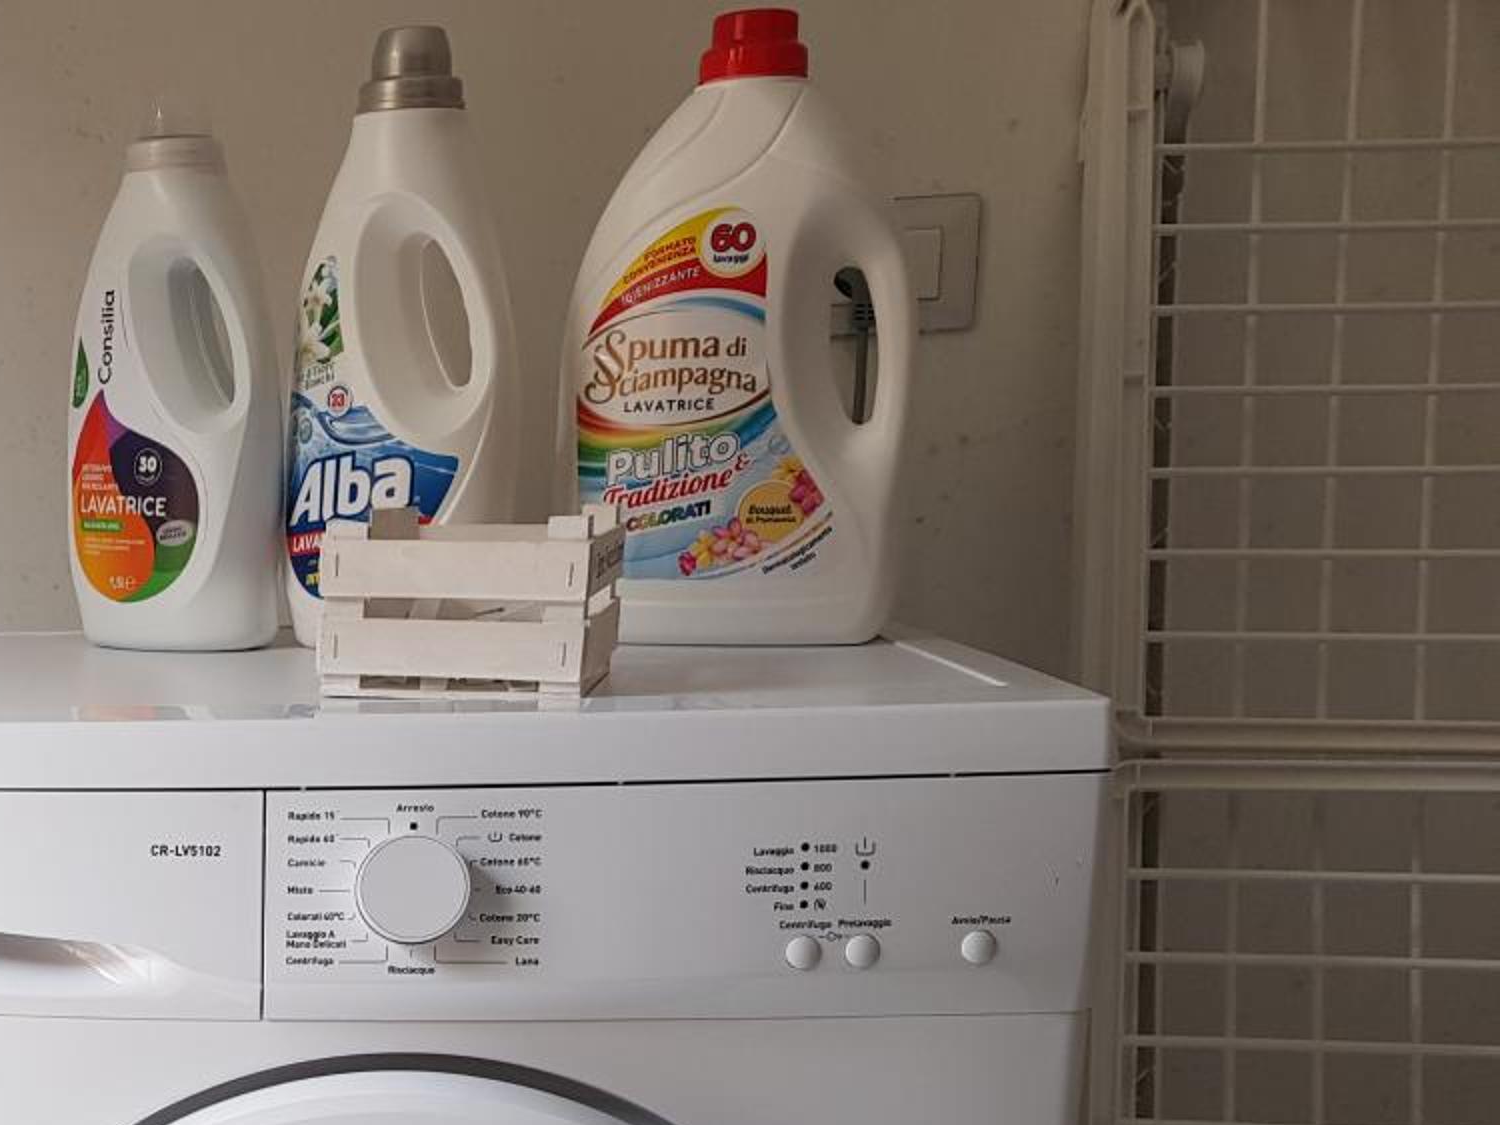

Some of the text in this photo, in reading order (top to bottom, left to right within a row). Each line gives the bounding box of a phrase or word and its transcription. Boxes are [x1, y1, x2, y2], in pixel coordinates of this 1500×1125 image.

[711, 222, 757, 253] 60
[644, 236, 697, 261] FORMATO
[713, 253, 750, 264] lavaggi
[623, 246, 697, 284] CONVENIENZA
[620, 266, 702, 305] IGIENIZZANTE
[97, 289, 116, 385] Consilia
[593, 330, 748, 380] Spuma di
[585, 360, 757, 405] Sciampagna
[624, 398, 715, 414] LAVATRICE
[607, 432, 740, 484] Pulito
[289, 456, 411, 527] Alba
[603, 468, 733, 508] Tradizione
[80, 495, 168, 518] LAVATRICE
[626, 500, 712, 532] COLORATI
[396, 803, 435, 813] Arresto
[480, 809, 516, 819] Cotone
[287, 811, 321, 822] Rapido
[287, 834, 321, 845] Rapido
[508, 832, 543, 843] Cotone
[150, 844, 222, 858] CR-LV5102
[753, 847, 795, 857] Lavaggio
[479, 857, 515, 868] Cotone
[813, 863, 833, 873] 800
[287, 885, 314, 895] Misto
[495, 885, 512, 895] Eco
[745, 881, 833, 895] Centrifuga 600
[773, 901, 795, 912] Fine
[287, 911, 323, 922] Colorati
[479, 912, 514, 923] Cotone
[779, 919, 833, 931] Centrifuga
[286, 929, 336, 942] Lavaggio A
[490, 935, 540, 946] Easy Care
[286, 939, 311, 949] Mano
[285, 956, 335, 968] Centrifuga
[515, 956, 540, 967] Lana
